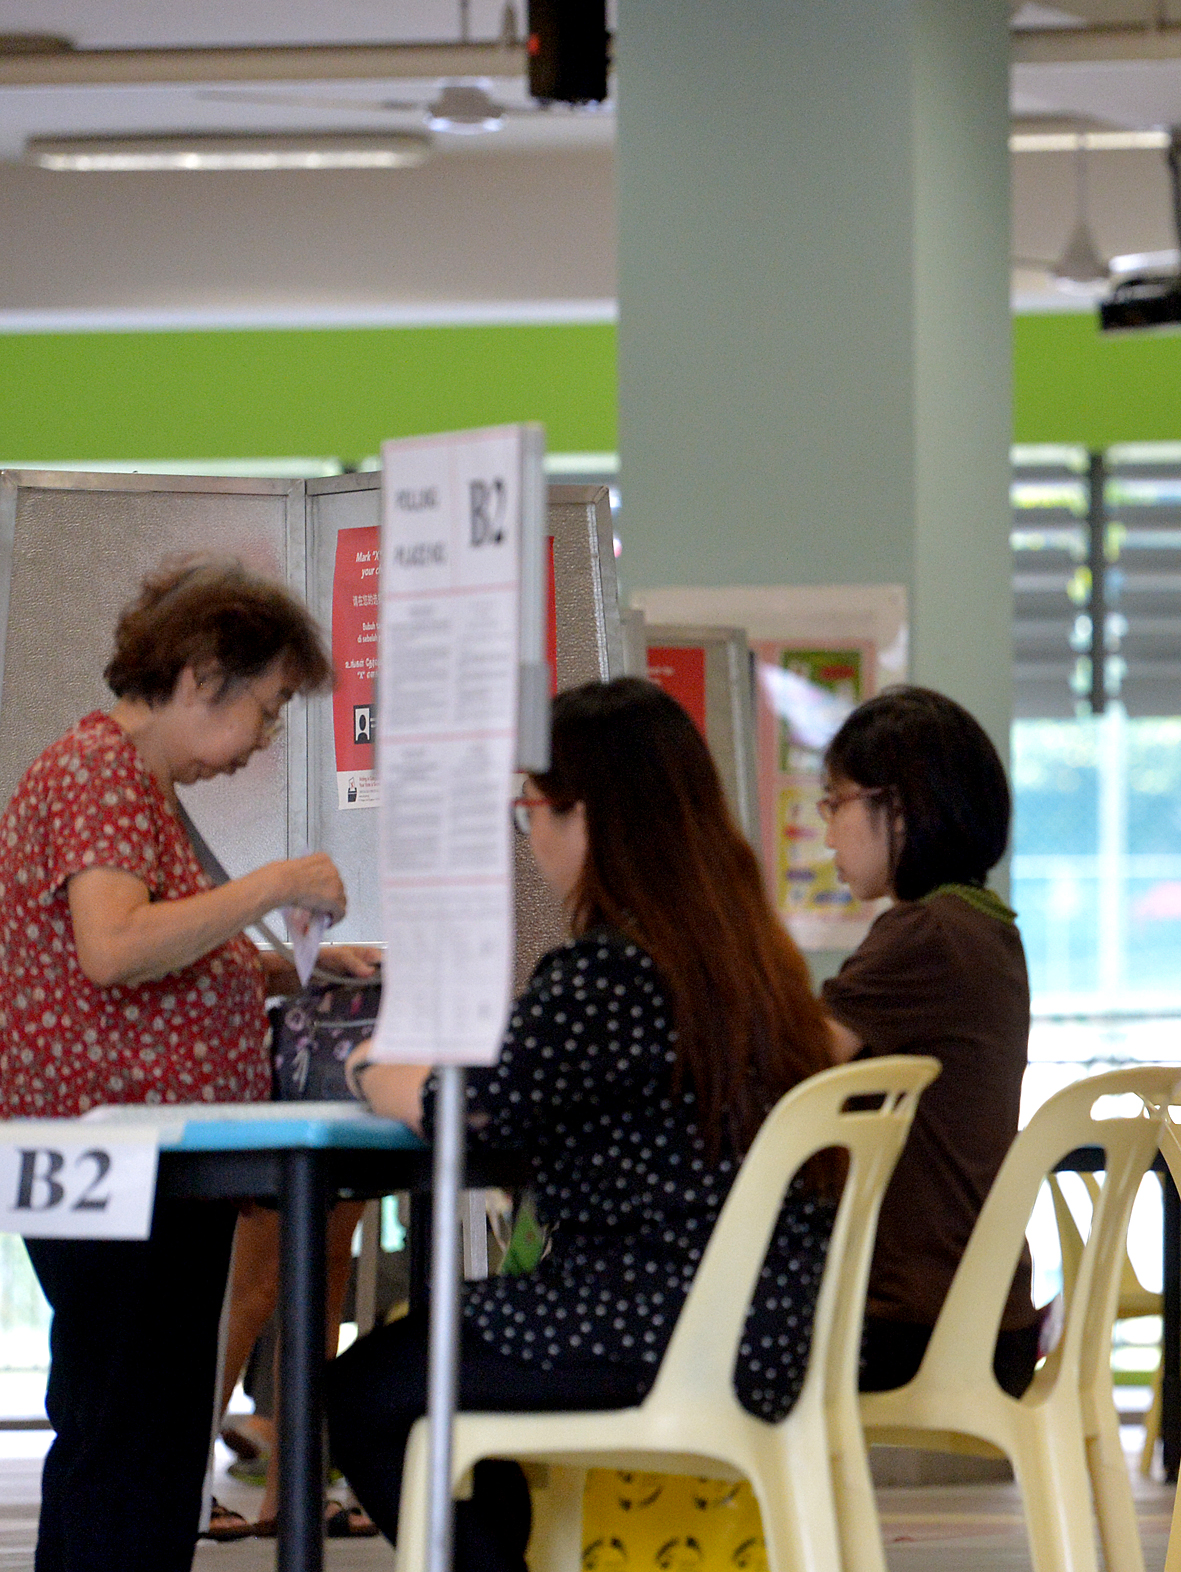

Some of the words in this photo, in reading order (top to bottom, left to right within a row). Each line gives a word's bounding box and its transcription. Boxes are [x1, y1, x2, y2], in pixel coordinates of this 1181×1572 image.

[468, 477, 507, 547] B2
[355, 550, 371, 562] Mark
[360, 567, 375, 579] your
[12, 1148, 112, 1212] B2
